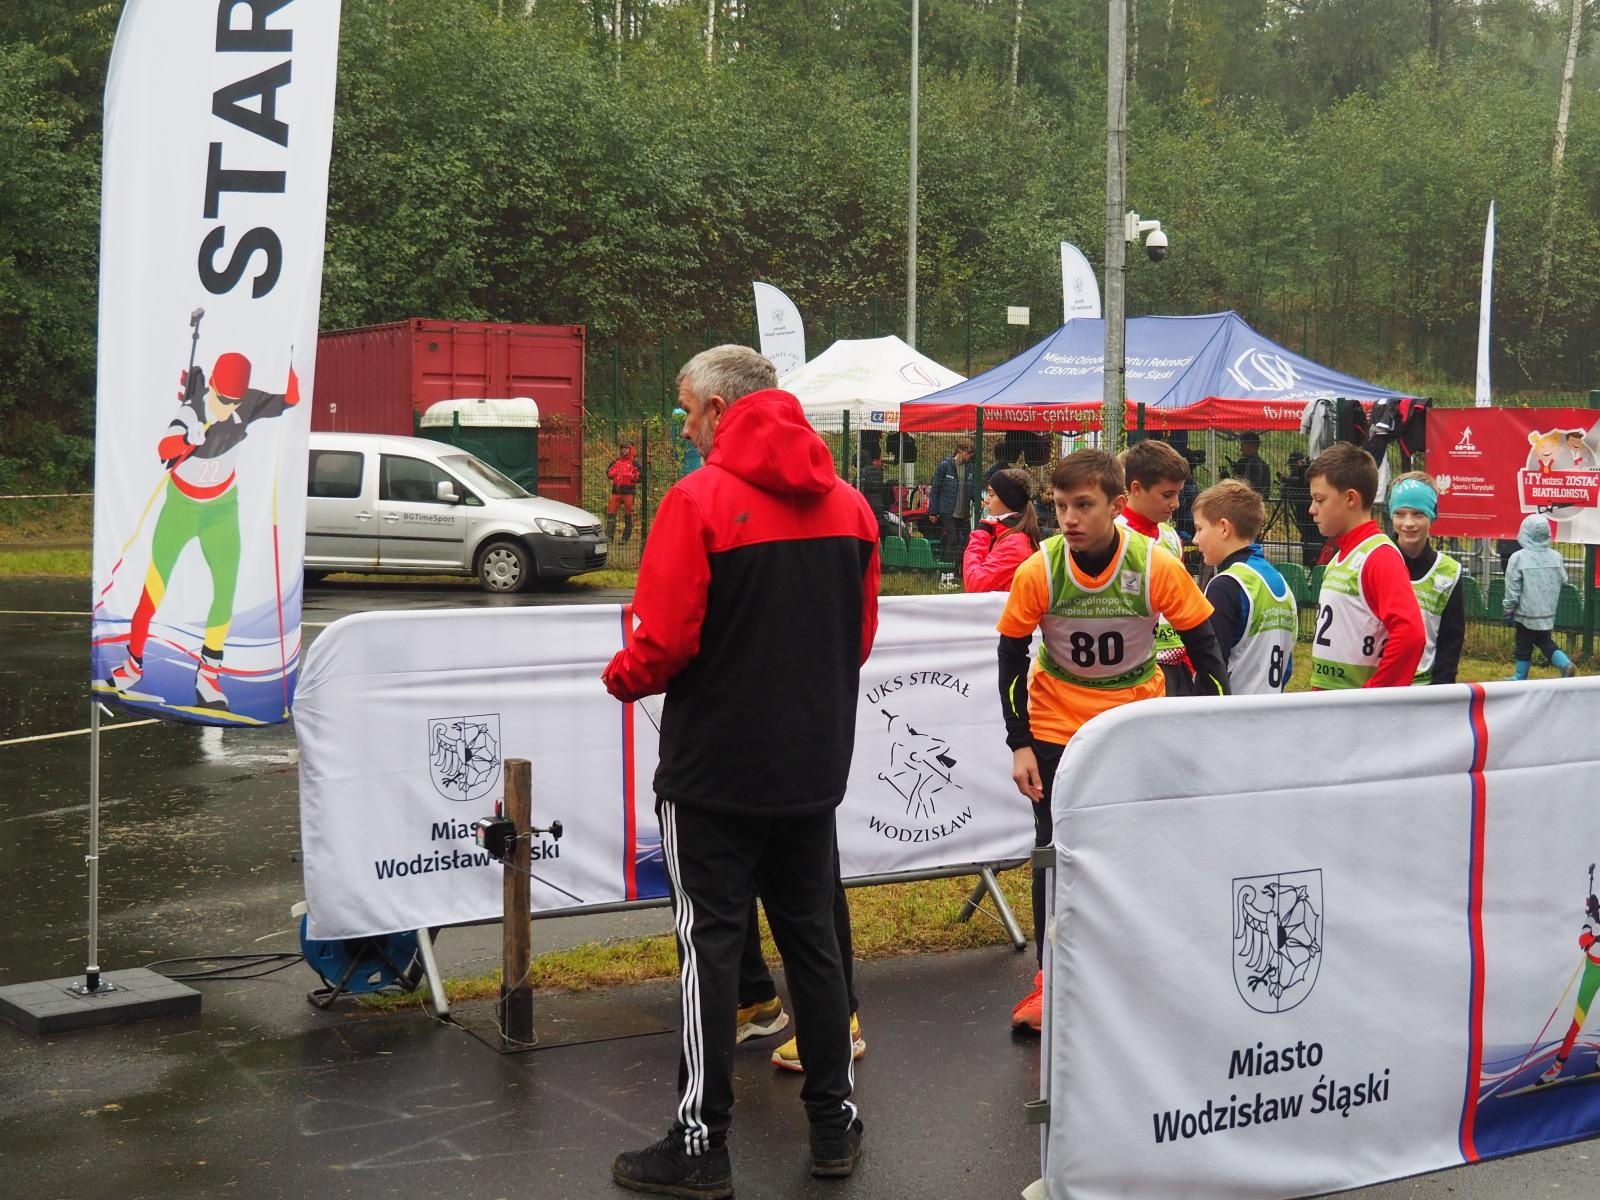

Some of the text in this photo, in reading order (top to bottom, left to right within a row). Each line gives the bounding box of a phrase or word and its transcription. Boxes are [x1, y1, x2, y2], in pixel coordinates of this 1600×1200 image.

[198, 0, 295, 299] STAR
[1043, 353, 1075, 365] Miejski
[1075, 356, 1105, 366] Ośrode
[1124, 357, 1143, 367] ortu
[1150, 356, 1194, 368] Rekreacji
[1144, 368, 1175, 380] Śląski
[1263, 405, 1304, 420] fb/mo
[1452, 483, 1469, 491] Sportu
[1472, 484, 1495, 492] Turystyki
[1527, 473, 1542, 485] TY
[1565, 475, 1599, 487] ZOSTAĆ
[1532, 488, 1590, 501] BIATHLONISTĄ
[403, 513, 455, 524] BGTimeSport
[1314, 604, 1333, 647] 2
[1070, 631, 1124, 668] 80
[1269, 645, 1284, 688] 8
[1317, 663, 1345, 678] 2012
[866, 671, 971, 705] UKS STRZAŁ
[431, 819, 480, 841] Mias
[869, 806, 973, 843] WODZISŁAW
[375, 850, 491, 880] Wodzisław
[1228, 1040, 1323, 1079] Miasto
[1153, 1068, 1390, 1143] Wodzisław Śląski
